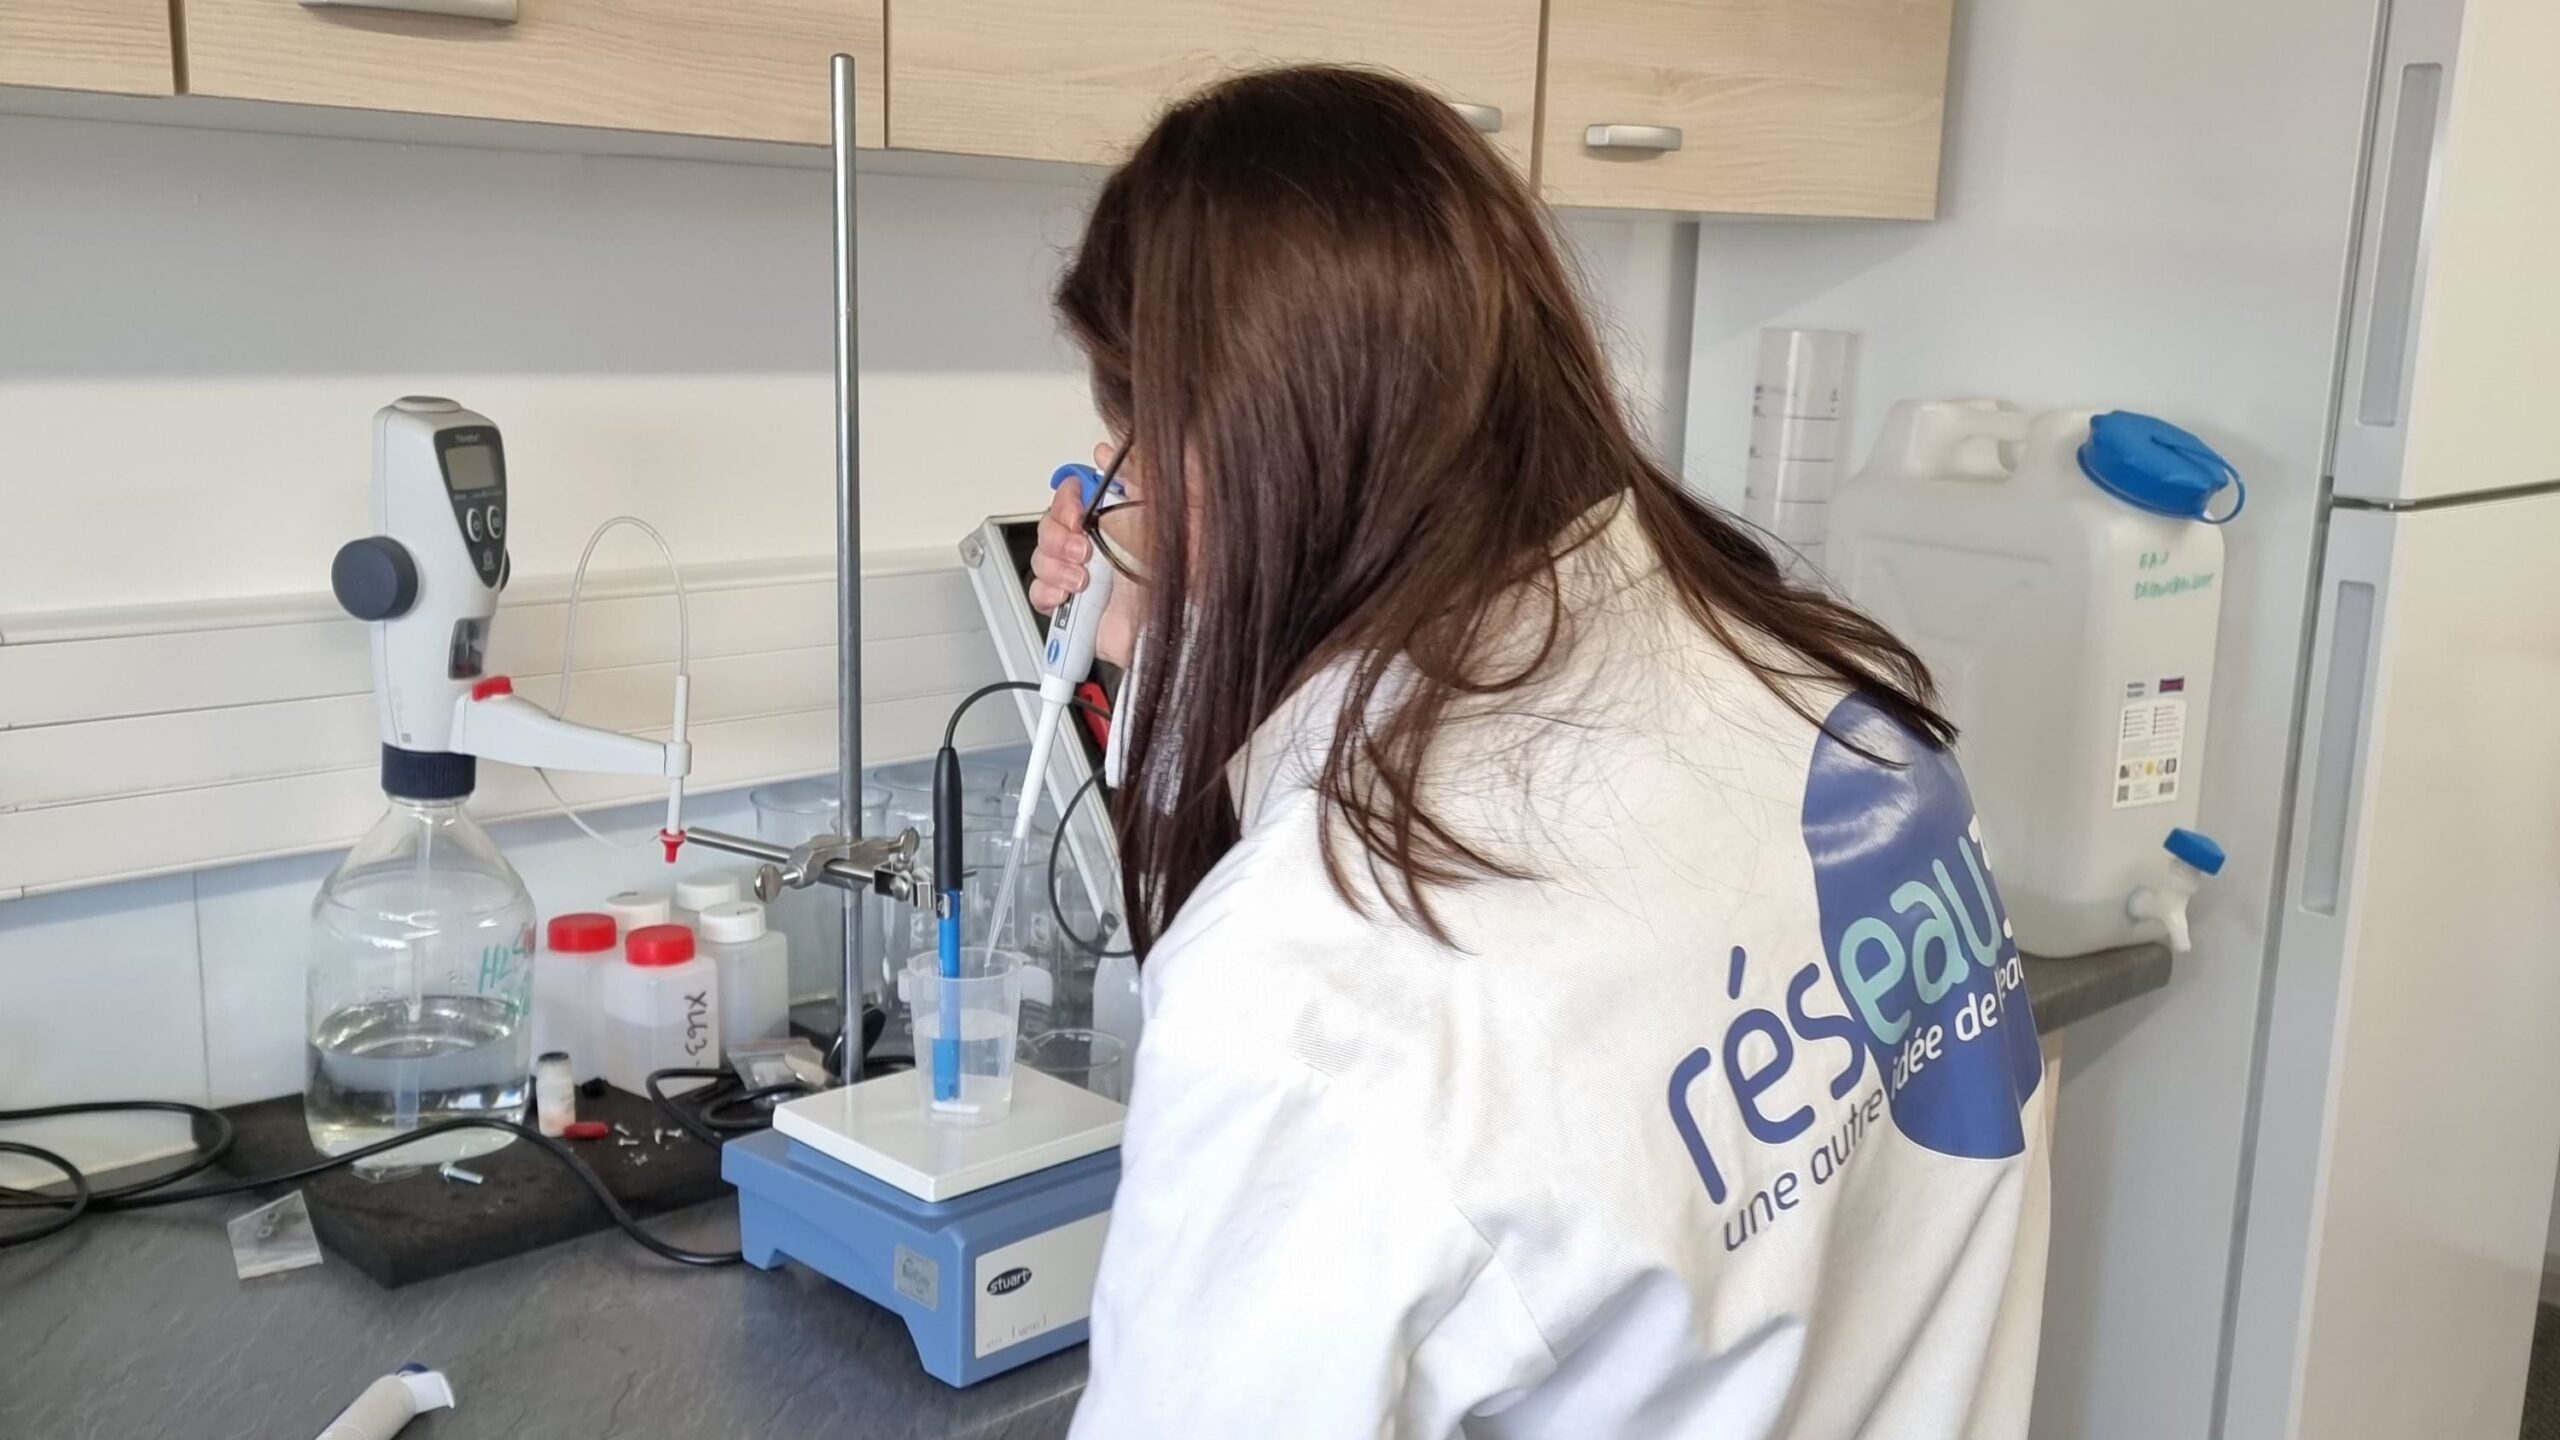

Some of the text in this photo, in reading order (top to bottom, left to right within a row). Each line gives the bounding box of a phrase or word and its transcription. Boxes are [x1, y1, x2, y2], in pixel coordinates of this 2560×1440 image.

[1724, 1172, 1799, 1252] une
[1811, 1088, 1884, 1184] autre
[1891, 1025, 1943, 1100] idée
[1955, 992, 1998, 1041] de
